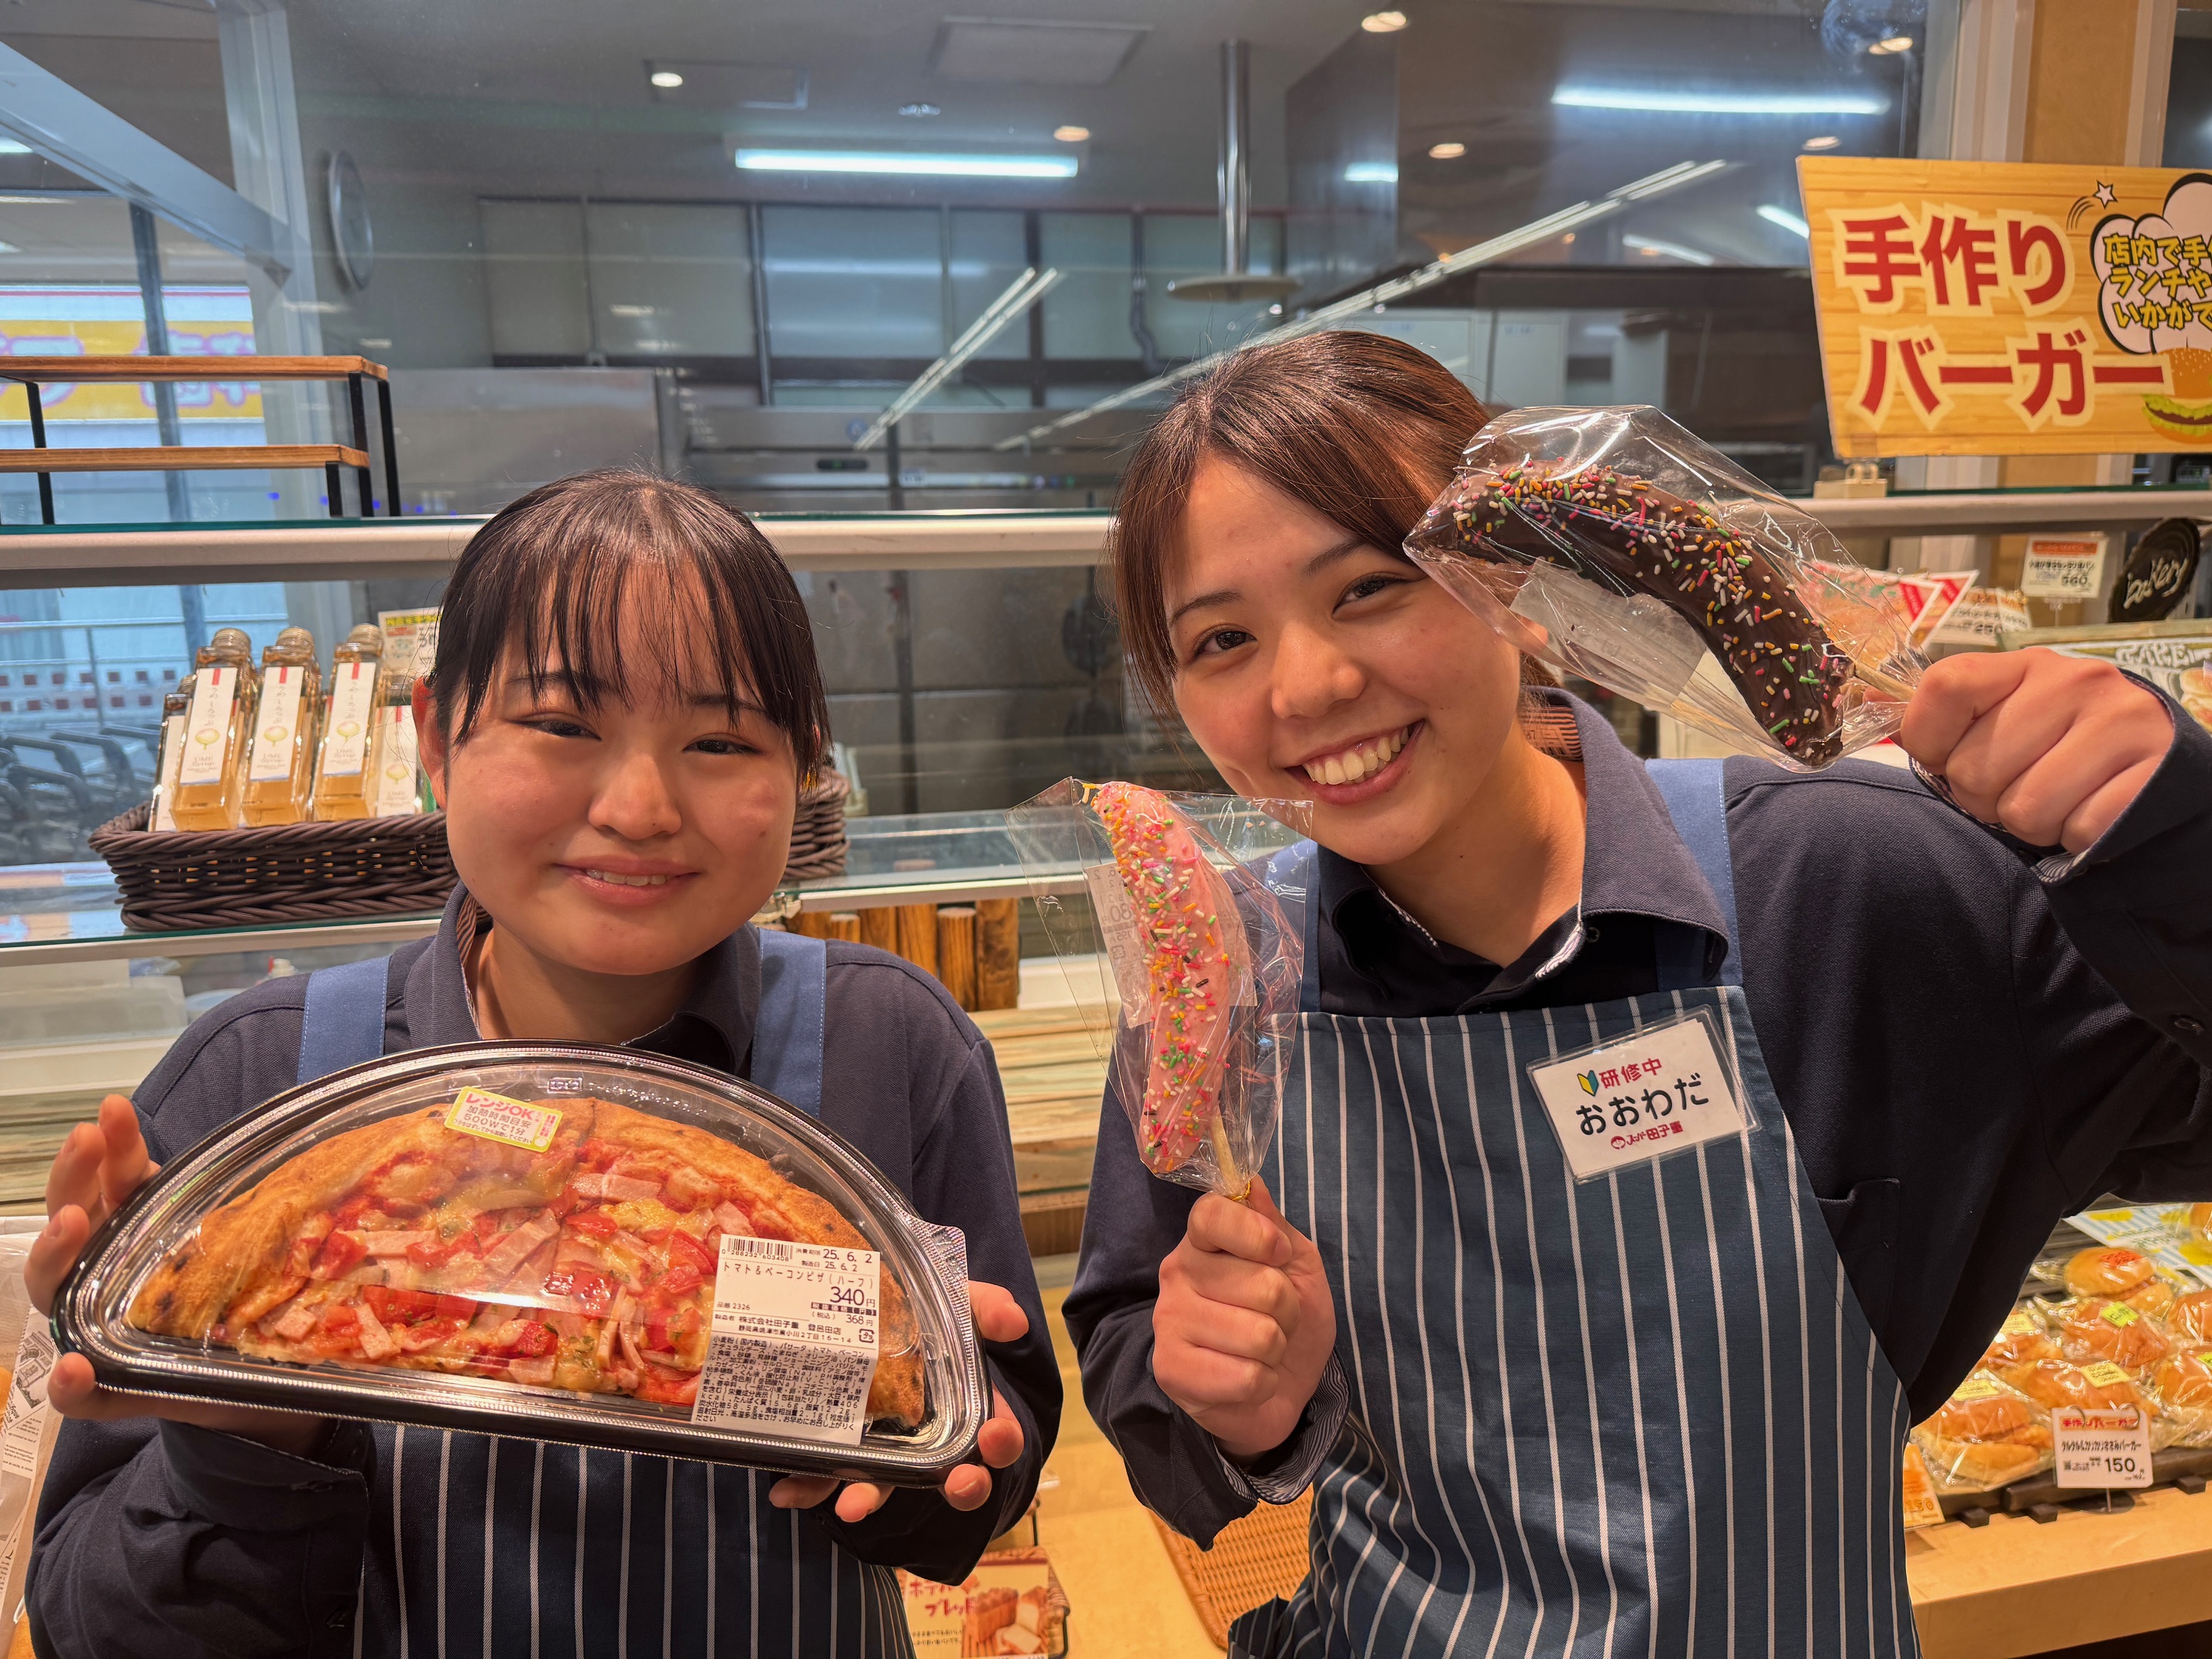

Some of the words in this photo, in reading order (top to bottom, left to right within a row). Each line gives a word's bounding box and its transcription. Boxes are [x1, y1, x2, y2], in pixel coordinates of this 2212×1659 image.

[1843, 215, 2066, 307] 手作り
[2102, 232, 2212, 266] 店内で手
[2109, 266, 2212, 299] ランチや
[1860, 328, 2164, 417] バーガー
[1599, 1057, 1663, 1089] 研修中
[466, 1093, 534, 1120] レンジOK
[467, 1105, 531, 1129] 加熱時間目安
[1575, 1072, 1709, 1135] おおわだ
[464, 1114, 525, 1135] 500Wで1分
[865, 1253, 872, 1263] 2
[830, 1286, 864, 1306] 340
[866, 1298, 875, 1307] 円
[846, 1314, 864, 1324] 368
[2105, 1458, 2135, 1472] 150
